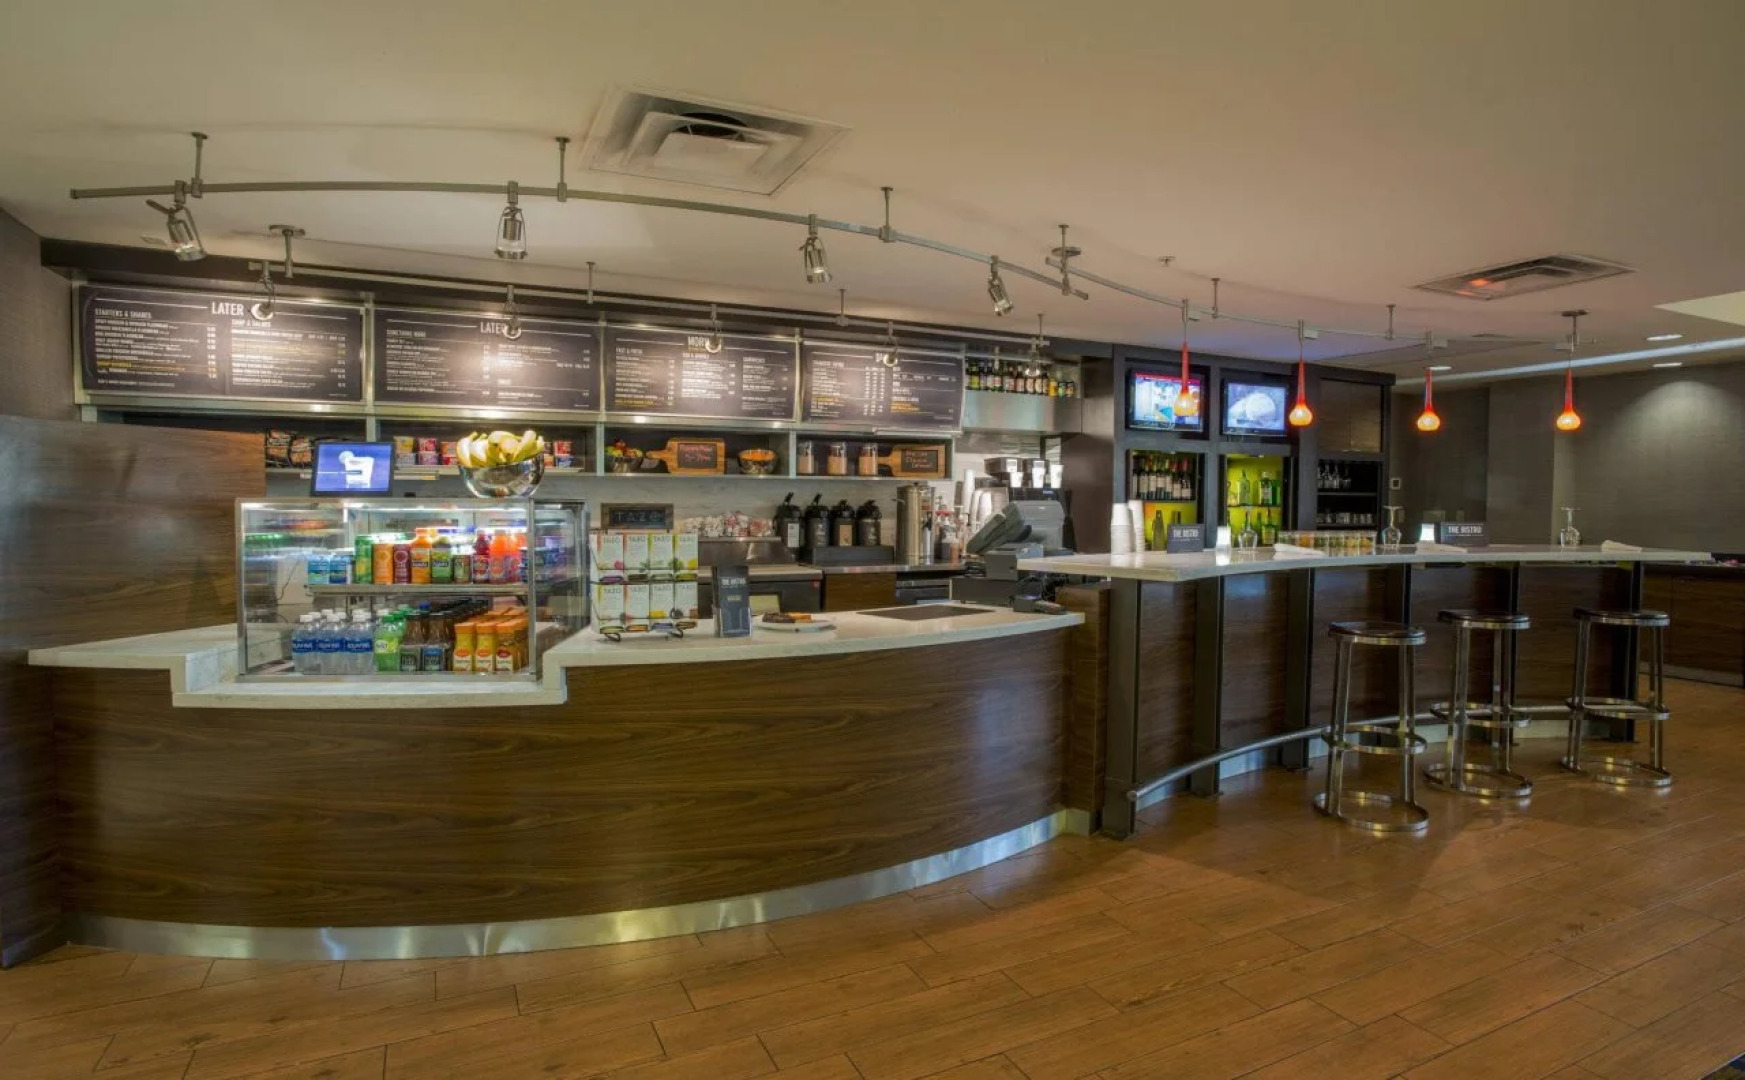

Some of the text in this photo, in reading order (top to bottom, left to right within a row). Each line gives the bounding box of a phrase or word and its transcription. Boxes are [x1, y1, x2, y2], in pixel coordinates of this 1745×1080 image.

[212, 302, 245, 316] LATER
[1448, 525, 1482, 534] THE BISTRO
